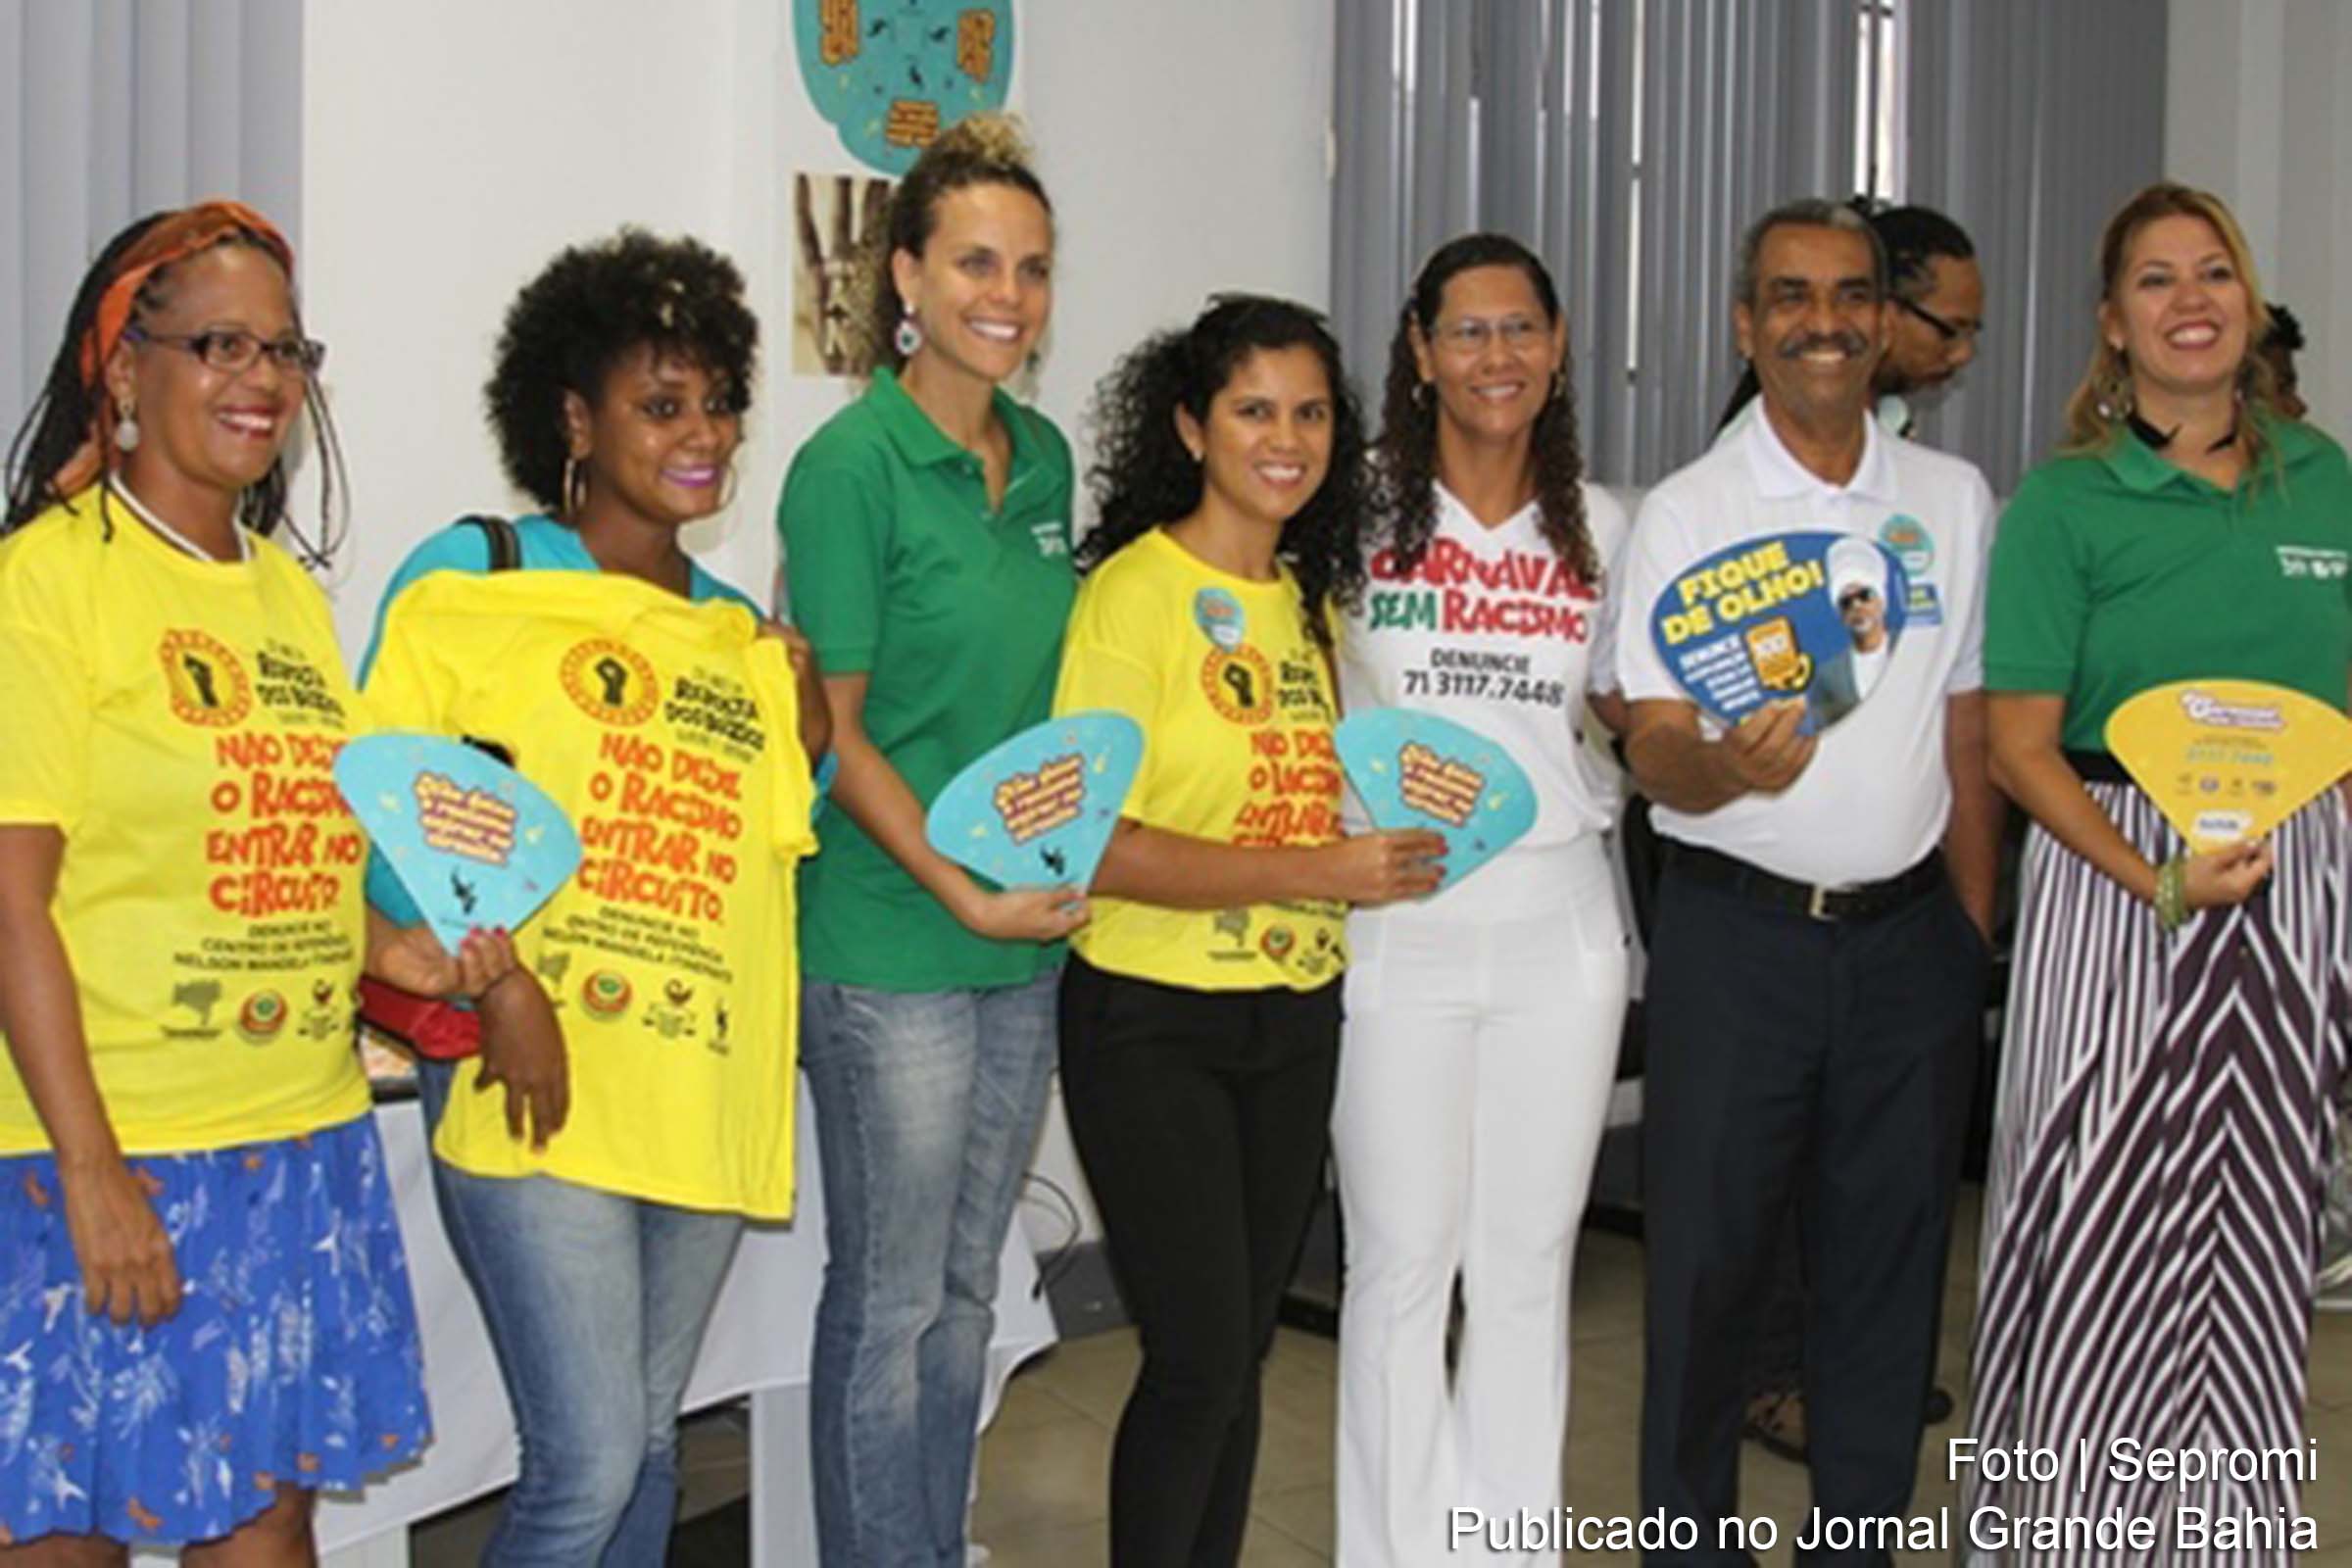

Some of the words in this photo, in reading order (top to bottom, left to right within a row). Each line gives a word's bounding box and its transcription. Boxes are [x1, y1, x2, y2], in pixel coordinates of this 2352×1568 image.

[1678, 541, 1788, 608] FIQUE
[1369, 591, 1438, 631] SEM
[1443, 589, 1588, 644] RACISMO
[1661, 605, 1713, 644] DE
[1717, 560, 1824, 622] OLHO!
[1430, 648, 1532, 675] DENUNCIE
[1403, 670, 1431, 696] 71
[1437, 672, 1565, 708] 3117.7448
[211, 781, 241, 814] O
[251, 771, 354, 818] RACISM
[1250, 765, 1268, 792] O
[589, 771, 613, 802] O
[619, 771, 742, 841] RACISMO
[207, 821, 318, 867] ENTRAR
[322, 833, 363, 864] NO
[581, 815, 702, 873] ENTRAR
[705, 851, 738, 885] NO
